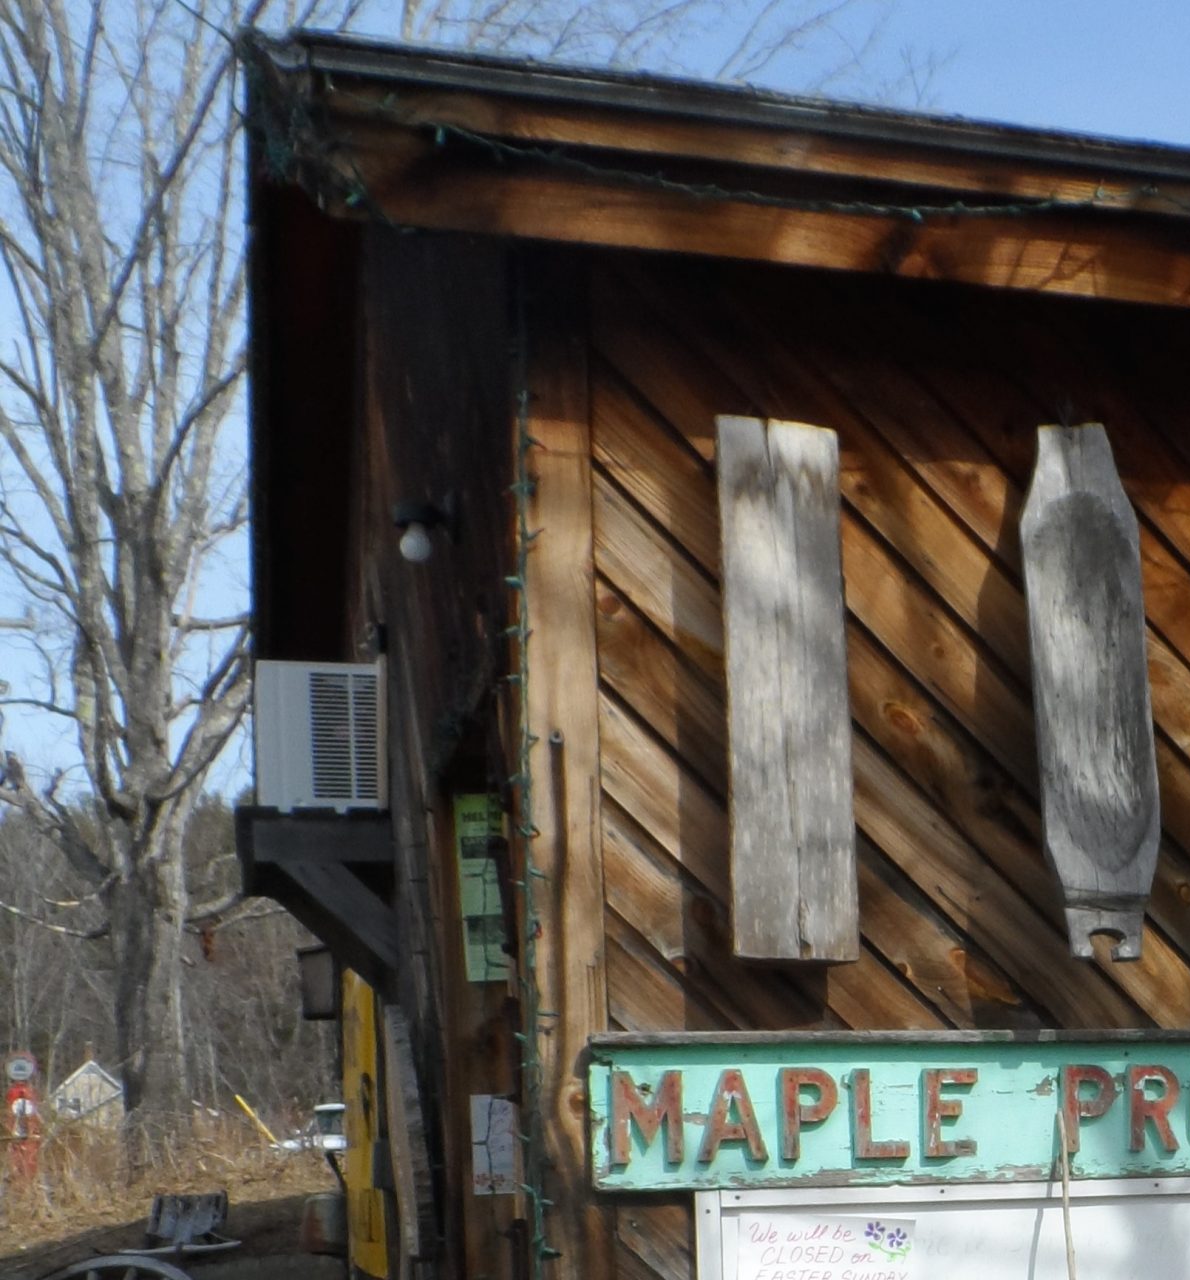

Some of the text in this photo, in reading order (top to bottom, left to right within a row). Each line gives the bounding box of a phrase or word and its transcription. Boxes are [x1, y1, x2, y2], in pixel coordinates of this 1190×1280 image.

[609, 1066, 979, 1165] MAPLE
[748, 1221, 857, 1243] We will be
[760, 1245, 876, 1266] CLOSED on
